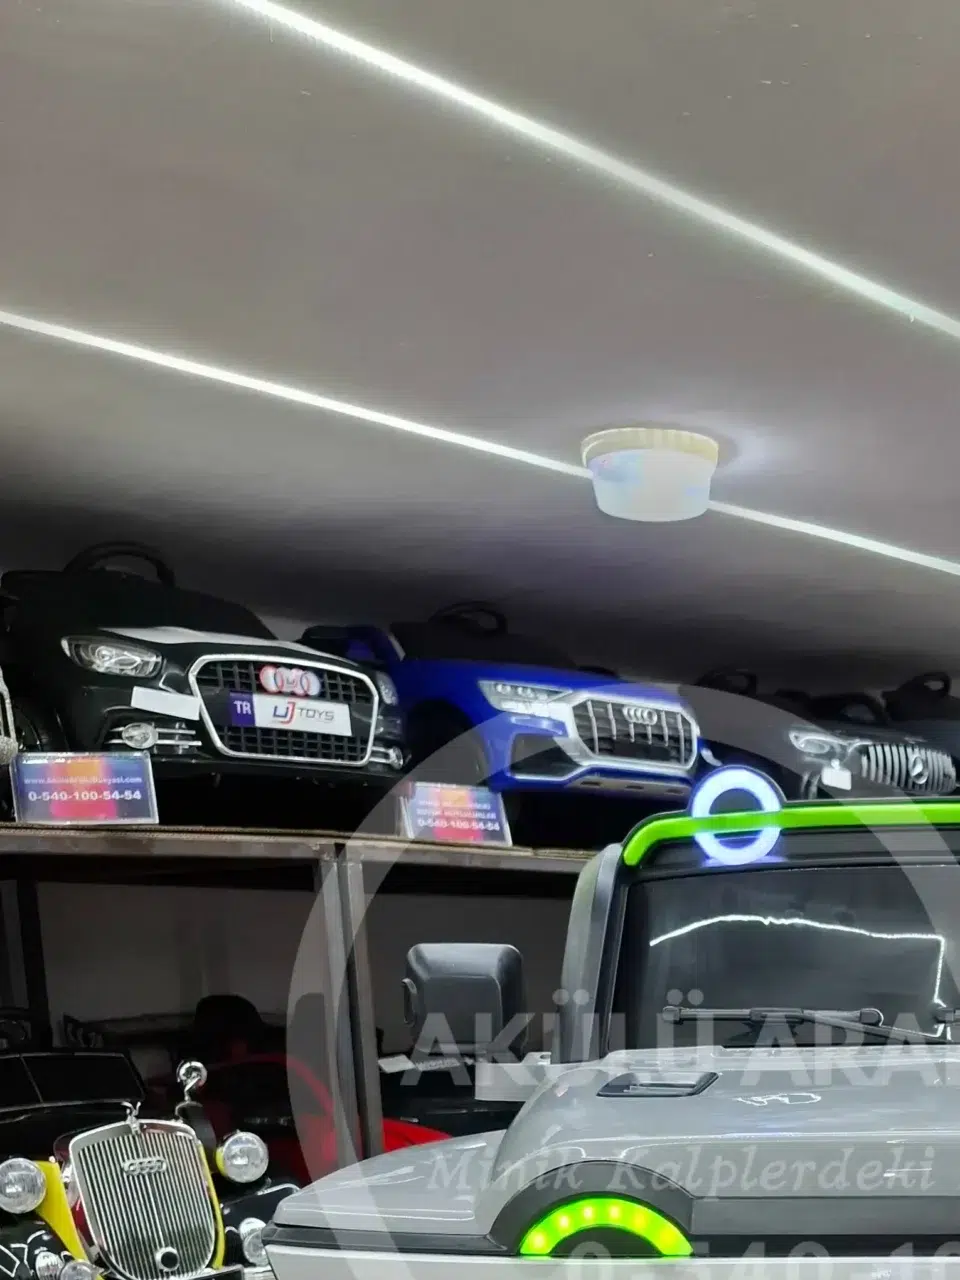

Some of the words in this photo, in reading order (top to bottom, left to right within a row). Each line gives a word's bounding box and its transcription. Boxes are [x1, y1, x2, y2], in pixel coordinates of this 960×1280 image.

[234, 700, 252, 715] TR
[297, 707, 335, 721] TOYS
[28, 789, 142, 802] 0-540-100-54-54
